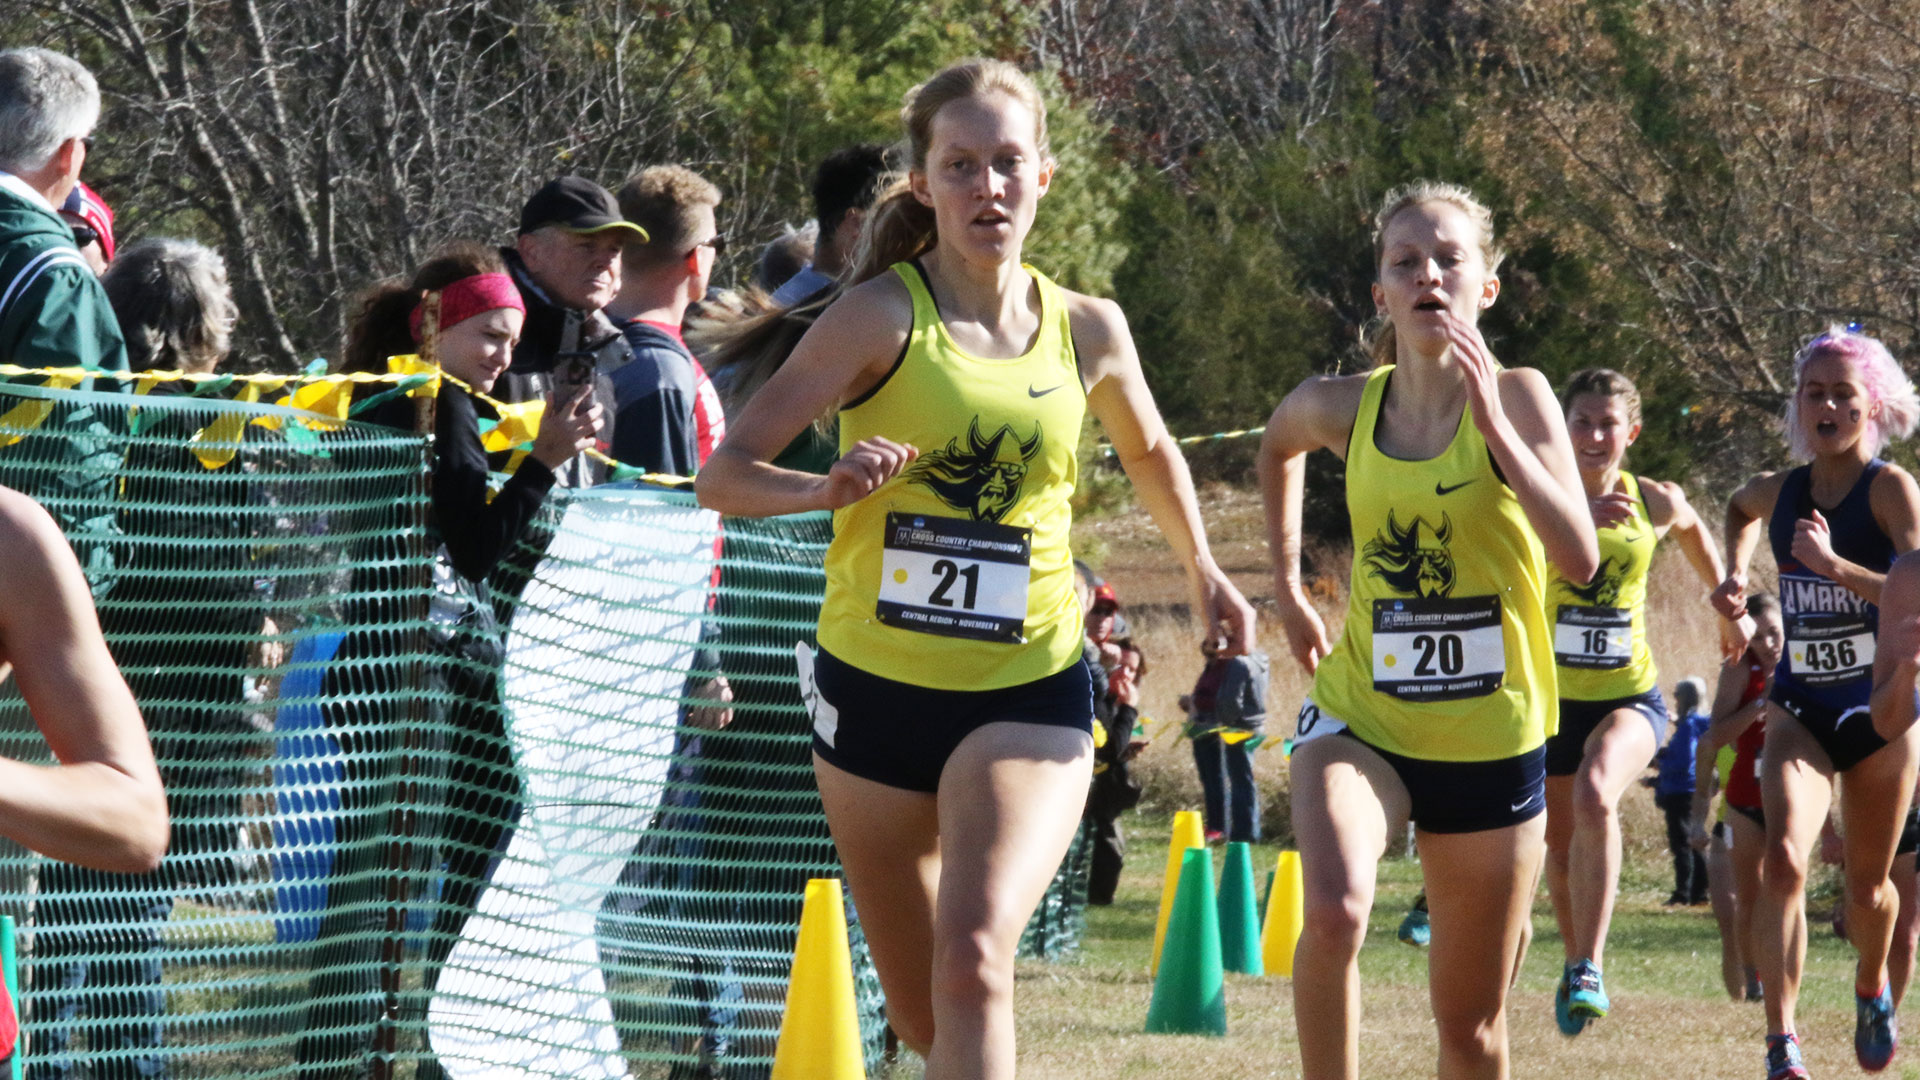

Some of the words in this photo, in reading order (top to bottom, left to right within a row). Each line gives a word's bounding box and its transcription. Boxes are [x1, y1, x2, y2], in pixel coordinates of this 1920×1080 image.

[911, 532, 936, 542] CROSS
[935, 535, 967, 547] COUNTRY
[967, 539, 1022, 553] CHAMPIONSHIPS
[929, 559, 979, 609] 21
[901, 610, 929, 622] CENTRAL
[928, 614, 954, 625] REGION
[958, 618, 993, 630] NOVEMBER
[1415, 614, 1442, 622] COUNTRY
[1581, 629, 1608, 655] 16
[1413, 634, 1463, 676] 20
[1805, 639, 1857, 672] 436
[1397, 685, 1420, 693] CENTRAL
